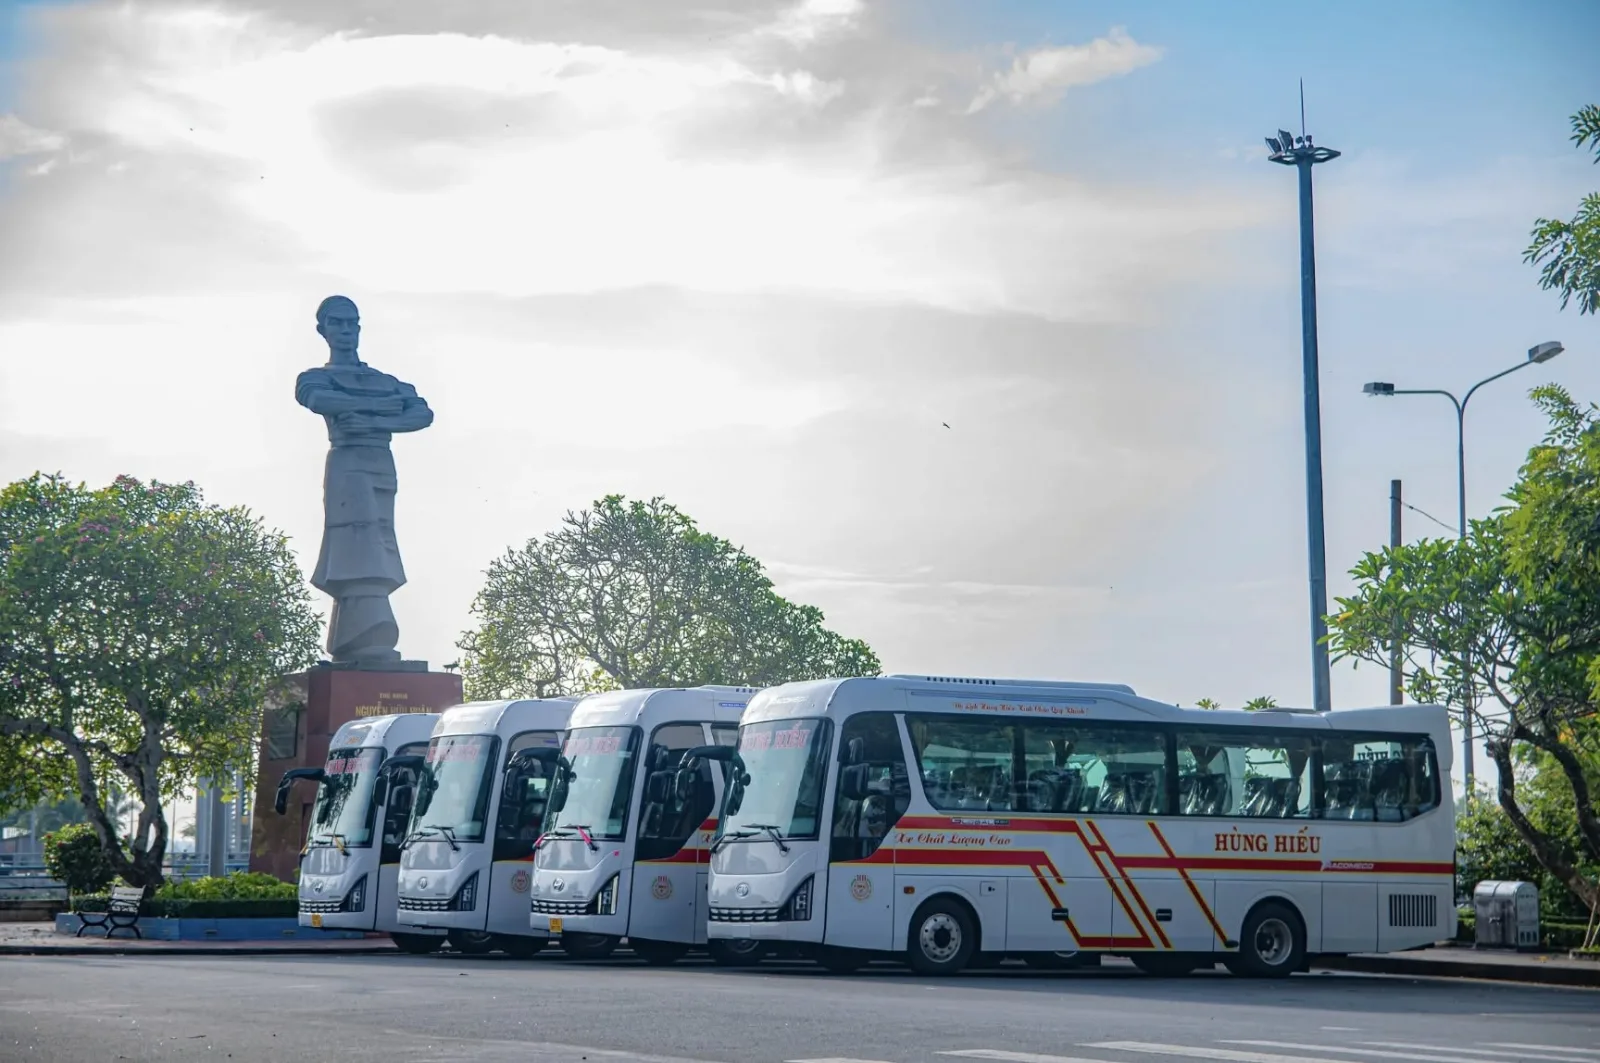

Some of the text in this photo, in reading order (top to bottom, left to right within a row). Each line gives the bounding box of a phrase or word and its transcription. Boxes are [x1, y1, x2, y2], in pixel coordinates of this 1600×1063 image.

[918, 832, 945, 845] Chất
[948, 833, 985, 847] Lượng
[989, 834, 1011, 846] Cao
[1215, 826, 1321, 853] HÙNG HIẾU
